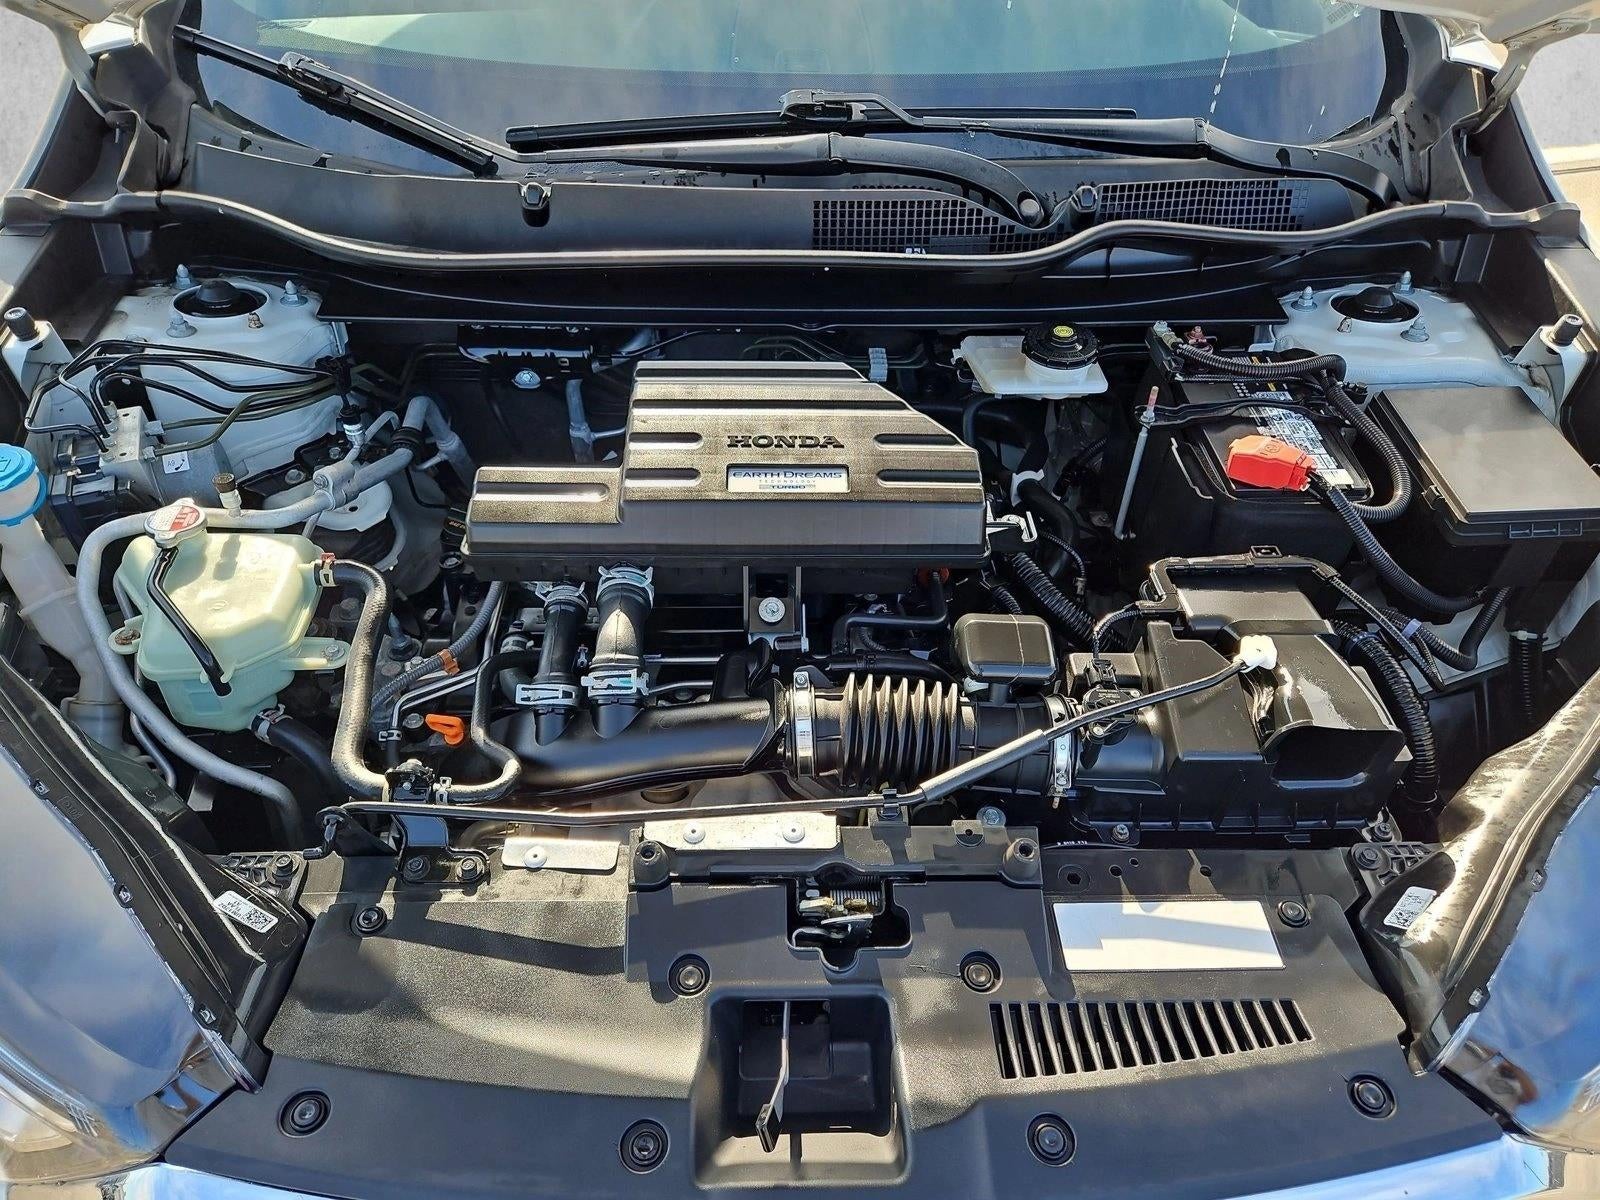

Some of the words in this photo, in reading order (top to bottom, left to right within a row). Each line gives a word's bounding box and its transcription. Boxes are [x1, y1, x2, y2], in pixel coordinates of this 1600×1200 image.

[727, 435, 845, 449] HONDA
[732, 471, 781, 479] EARTH
[783, 470, 843, 479] DREAMS
